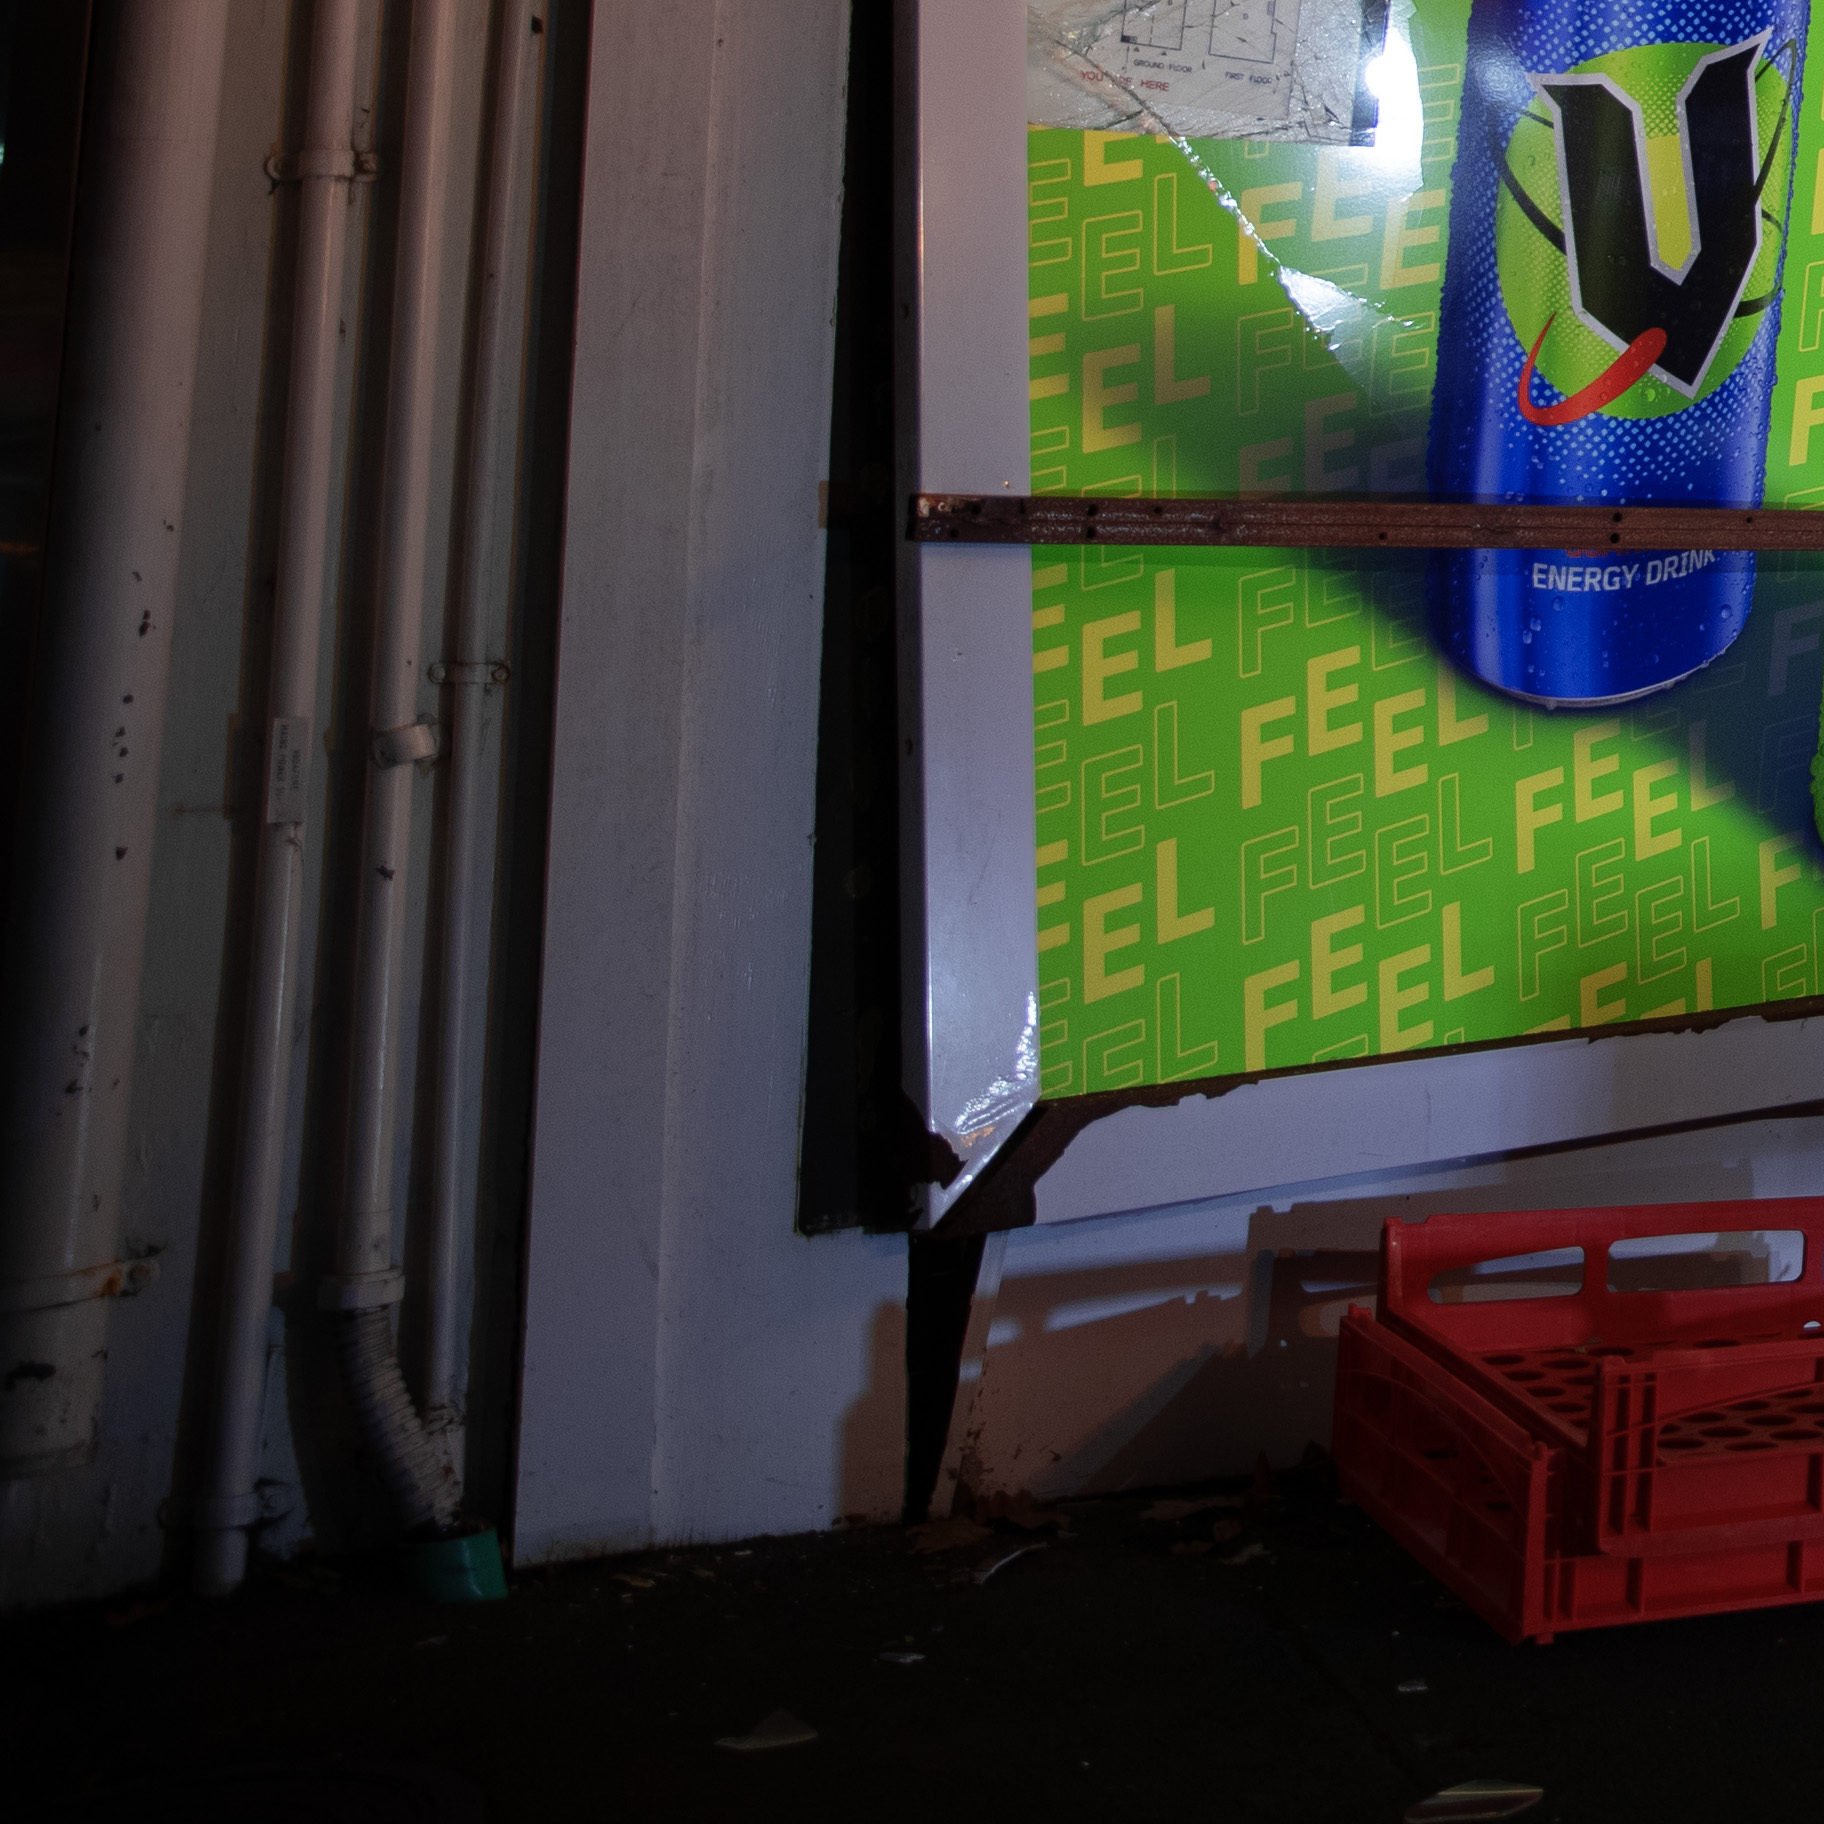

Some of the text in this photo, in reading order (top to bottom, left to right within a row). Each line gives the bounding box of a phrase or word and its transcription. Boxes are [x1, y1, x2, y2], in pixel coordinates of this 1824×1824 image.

[1133, 59, 1192, 73] GROUND FLOOR
[1141, 79, 1170, 91] HERE
[1030, 159, 1212, 321] EEL
[1238, 144, 1446, 290] FEE
[1528, 26, 1772, 399] V
[1029, 293, 1211, 454] EEL
[1033, 562, 1212, 726] EEL
[1532, 549, 1715, 592] ENERGY DRINK
[1034, 699, 1214, 867] EEL
[1241, 646, 1489, 810] FEEL
[1515, 720, 1737, 874] FEEL
[1036, 837, 1215, 1004] EEL
[1241, 773, 1493, 945] FEEL
[1517, 837, 1740, 1001] FEEL
[1244, 901, 1494, 1072] FEEL
